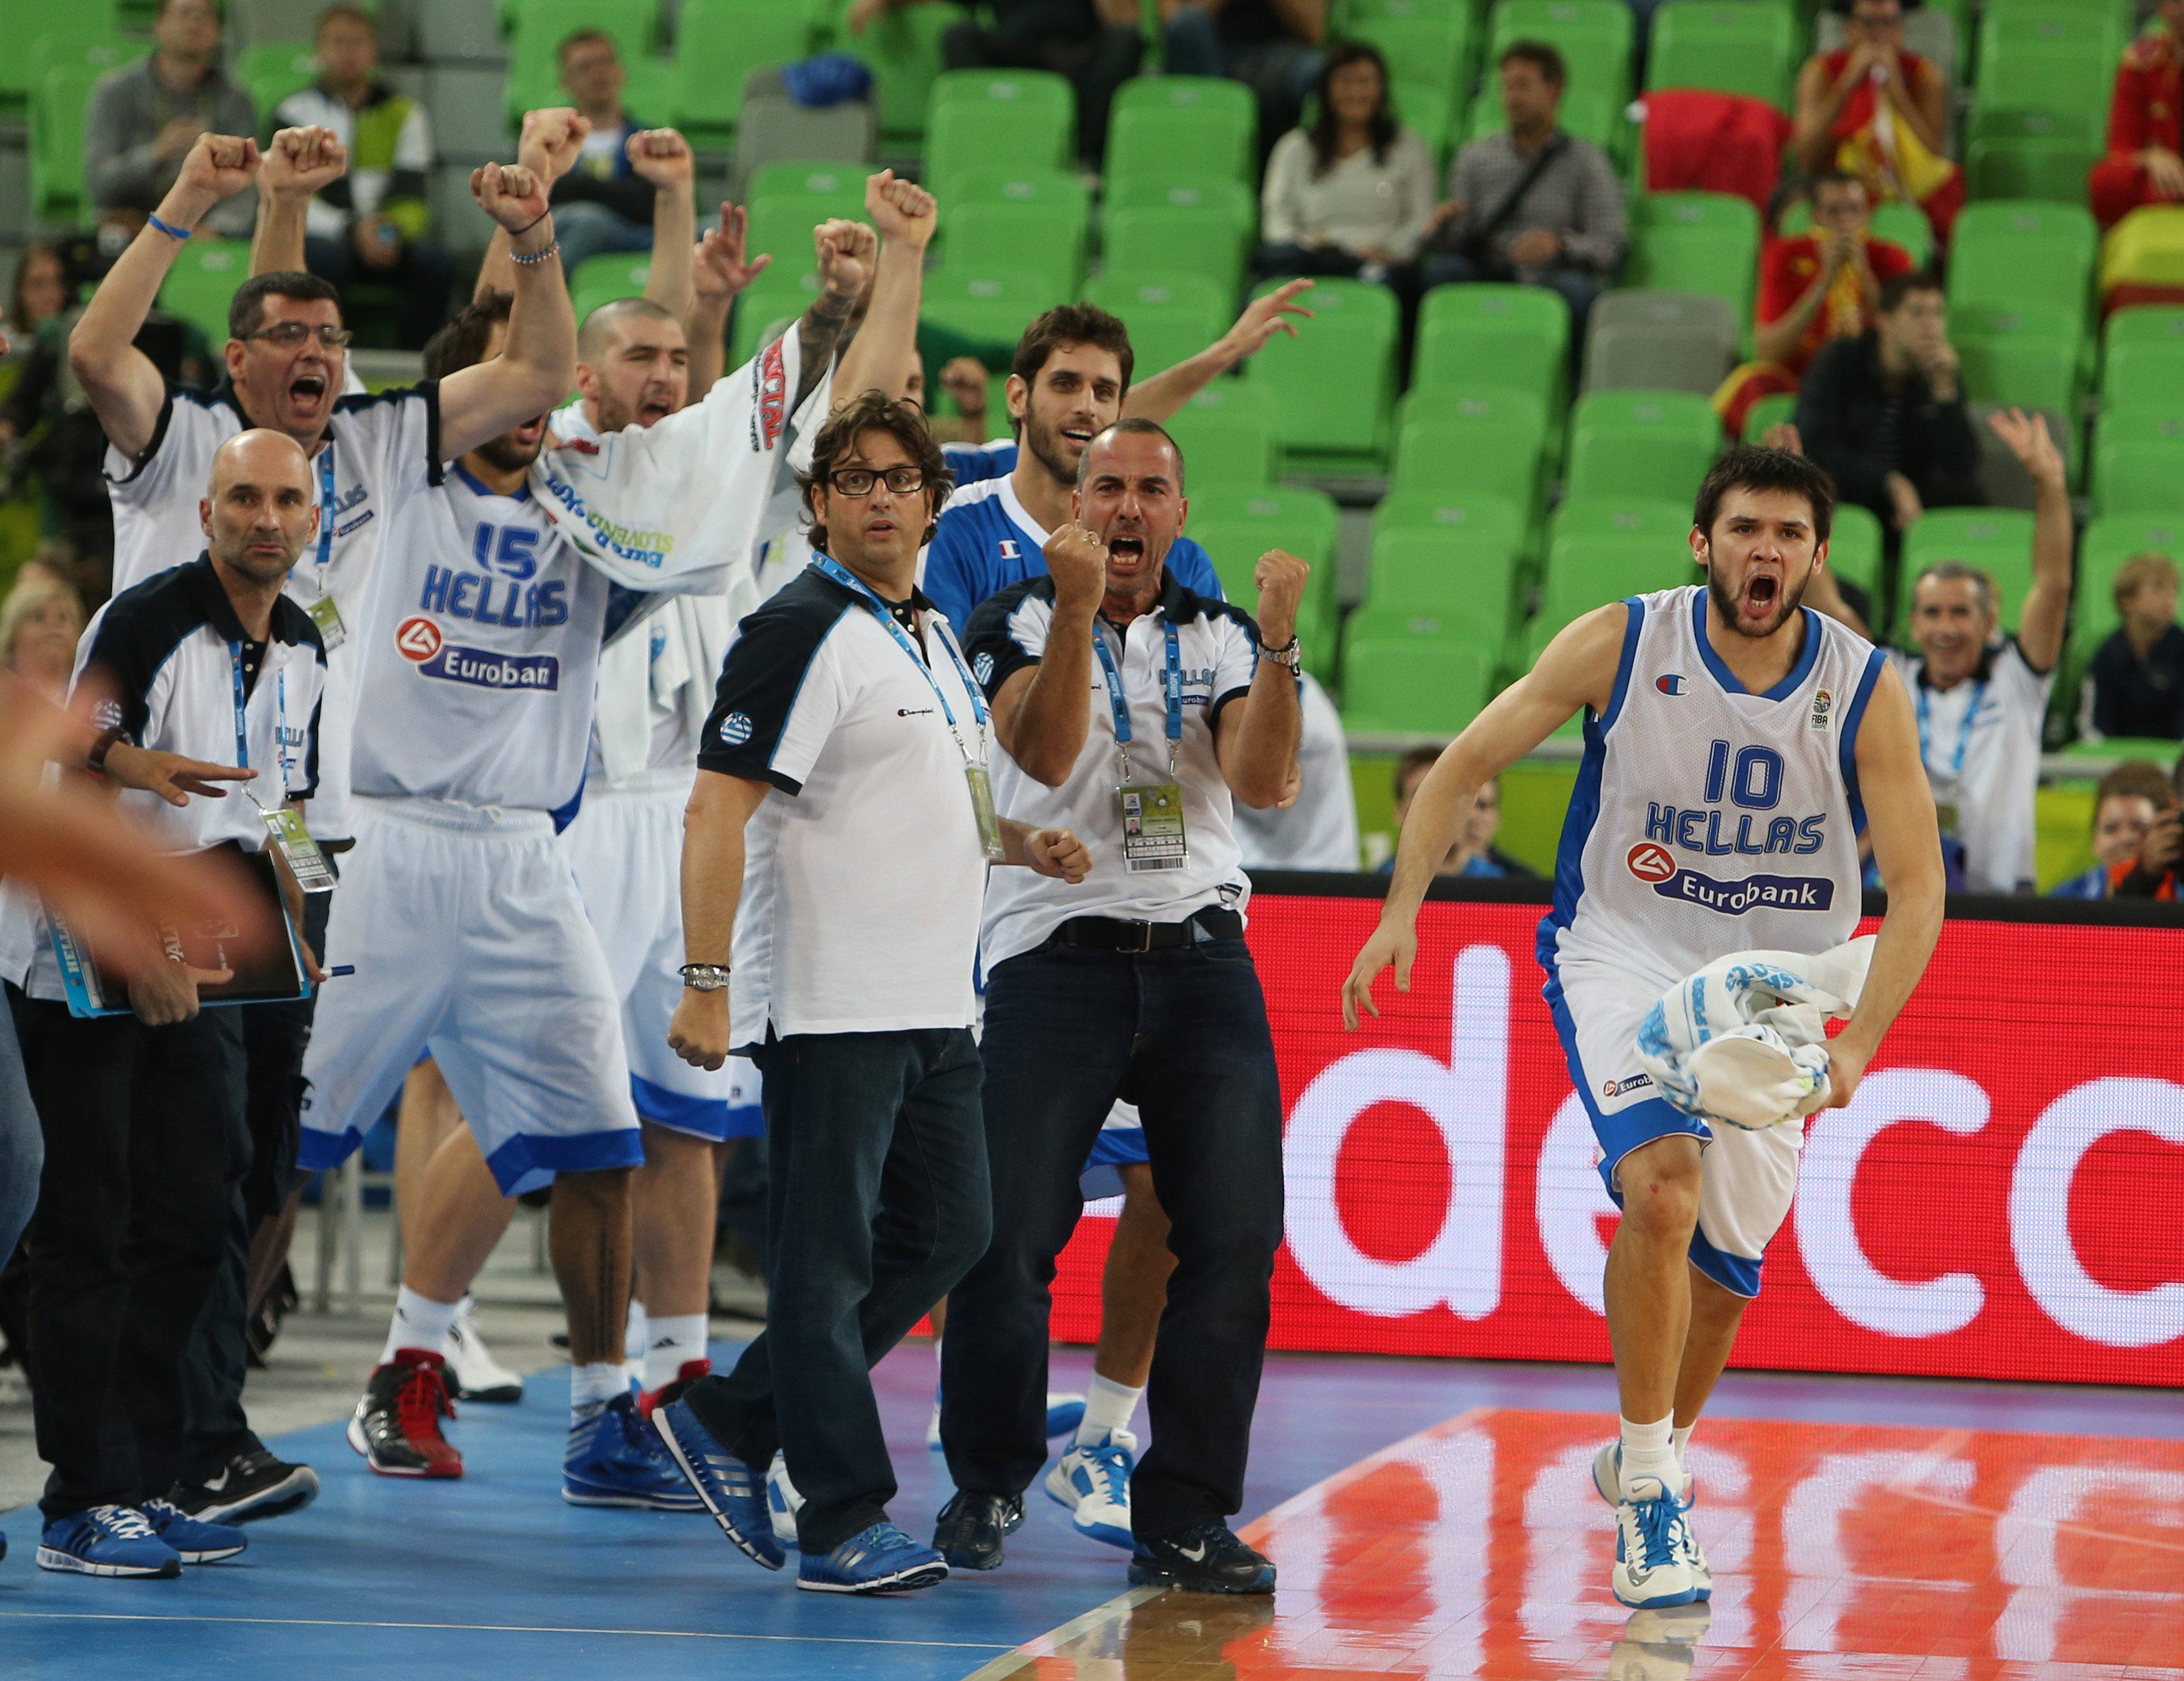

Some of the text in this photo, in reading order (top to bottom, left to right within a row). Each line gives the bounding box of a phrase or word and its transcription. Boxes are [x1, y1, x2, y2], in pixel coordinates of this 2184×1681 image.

[473, 521, 540, 580] 15
[420, 564, 568, 628] HELLAS
[443, 651, 550, 685] Euroban
[1812, 714, 1828, 725] FIBA
[1704, 739, 1785, 810] 10
[1645, 801, 1826, 855] HELLAS
[1682, 875, 1818, 910] Eurobank
[1619, 1075, 1652, 1092] Eurob
